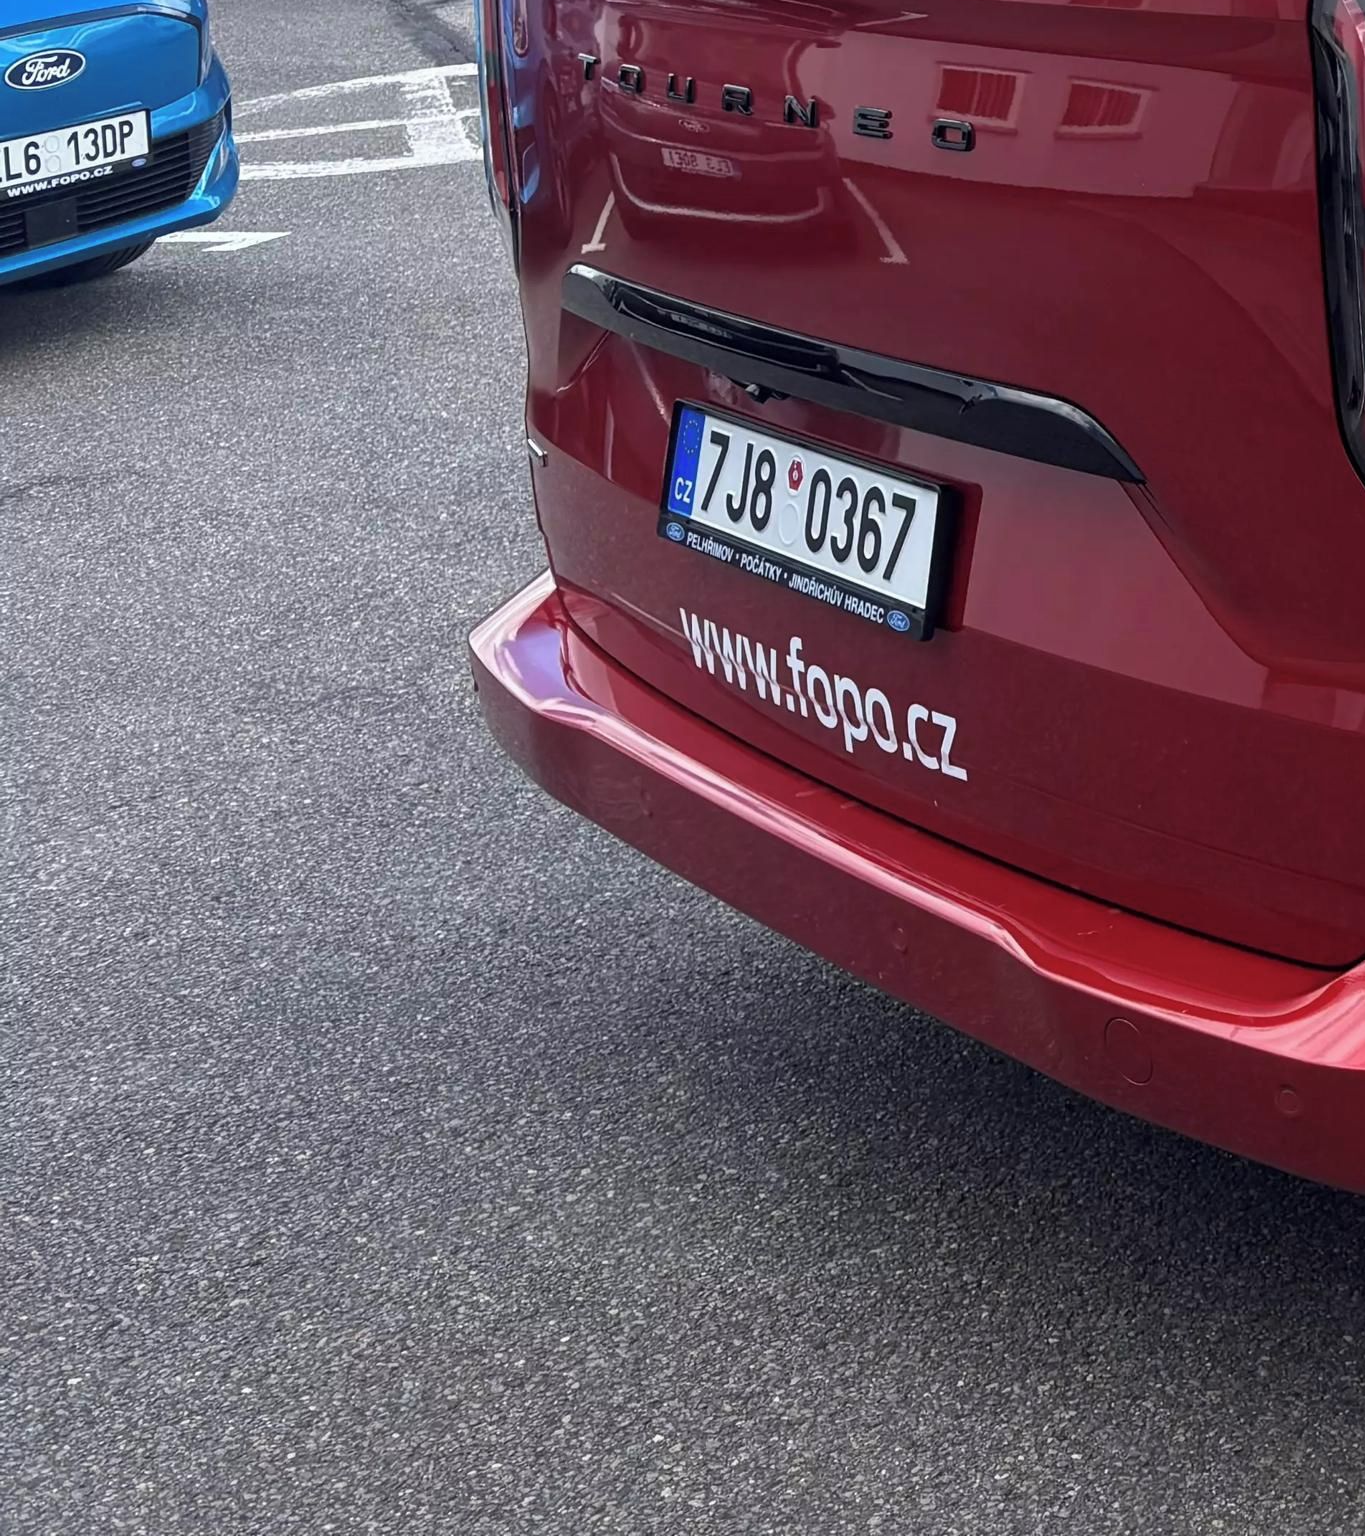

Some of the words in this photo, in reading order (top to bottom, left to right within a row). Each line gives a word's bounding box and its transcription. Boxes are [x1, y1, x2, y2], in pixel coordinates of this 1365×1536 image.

[22, 55, 71, 86] Ford
[578, 52, 977, 152] TOURNEO
[0, 140, 42, 184] L6
[67, 119, 134, 166] 13DP
[7, 165, 114, 198] WWW.FOPO.CZ
[674, 476, 692, 503] CZ
[701, 429, 777, 532] 7J8
[804, 467, 918, 582] 0367
[686, 530, 734, 563] PELHŘIMOV
[740, 552, 782, 583] POČÁTKY
[844, 593, 885, 624] HRADEC
[679, 607, 968, 782] www.fopo.cz
